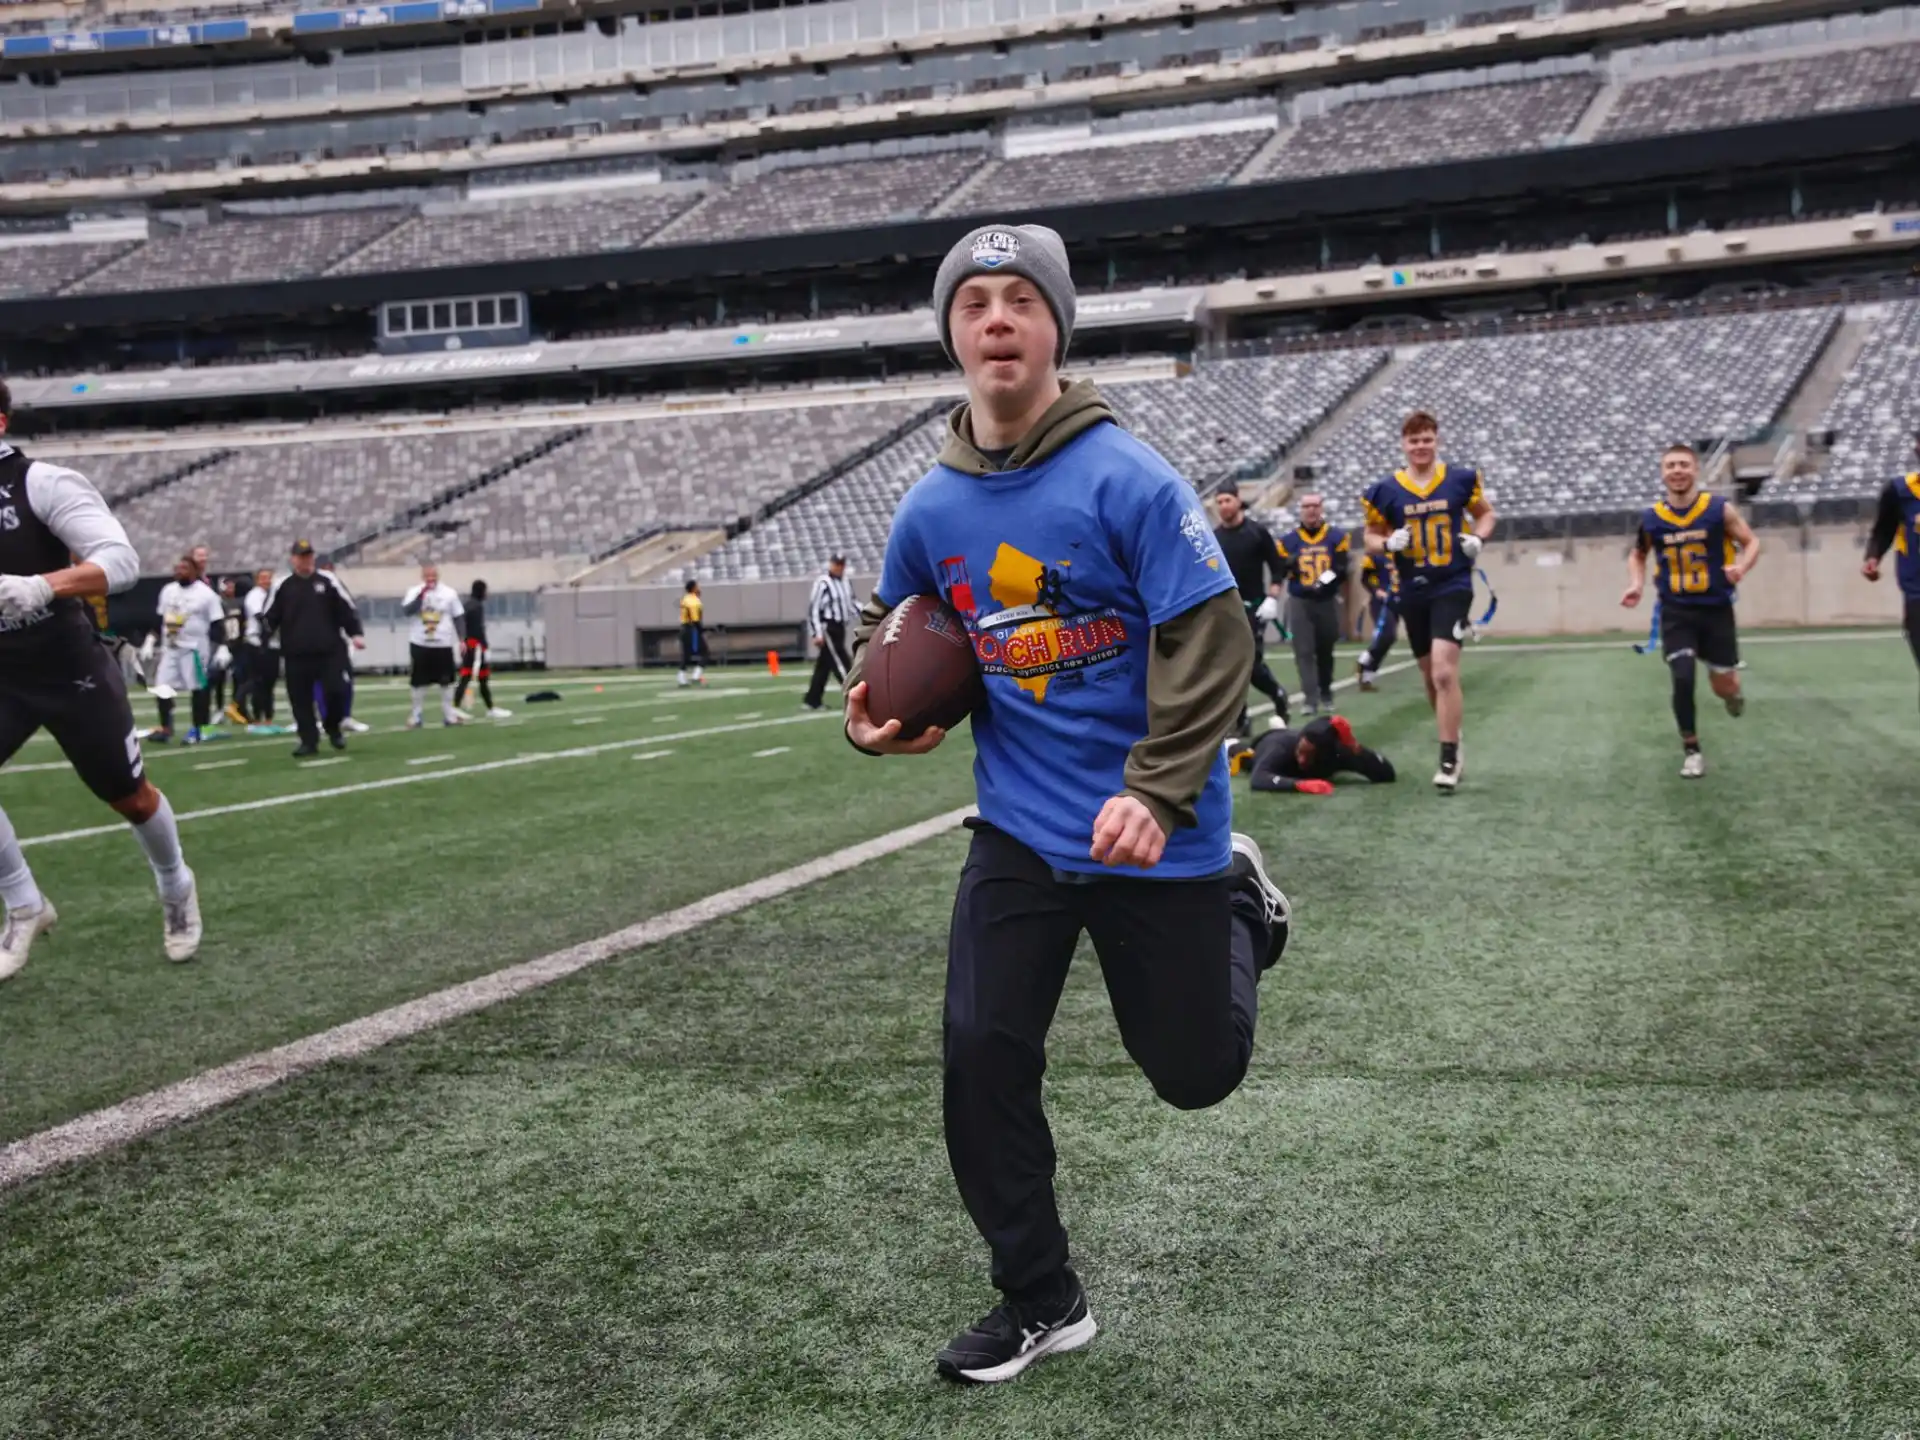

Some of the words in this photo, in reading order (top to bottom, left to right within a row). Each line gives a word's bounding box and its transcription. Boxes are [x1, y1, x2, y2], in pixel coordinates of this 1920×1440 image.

[1415, 267, 1468, 281] MetLife
[1402, 512, 1453, 568] 40
[1662, 543, 1710, 594] 16
[968, 630, 1052, 668] TOCH
[1054, 616, 1128, 658] RUN
[1063, 659, 1084, 669] new
[1086, 648, 1119, 665] jersey
